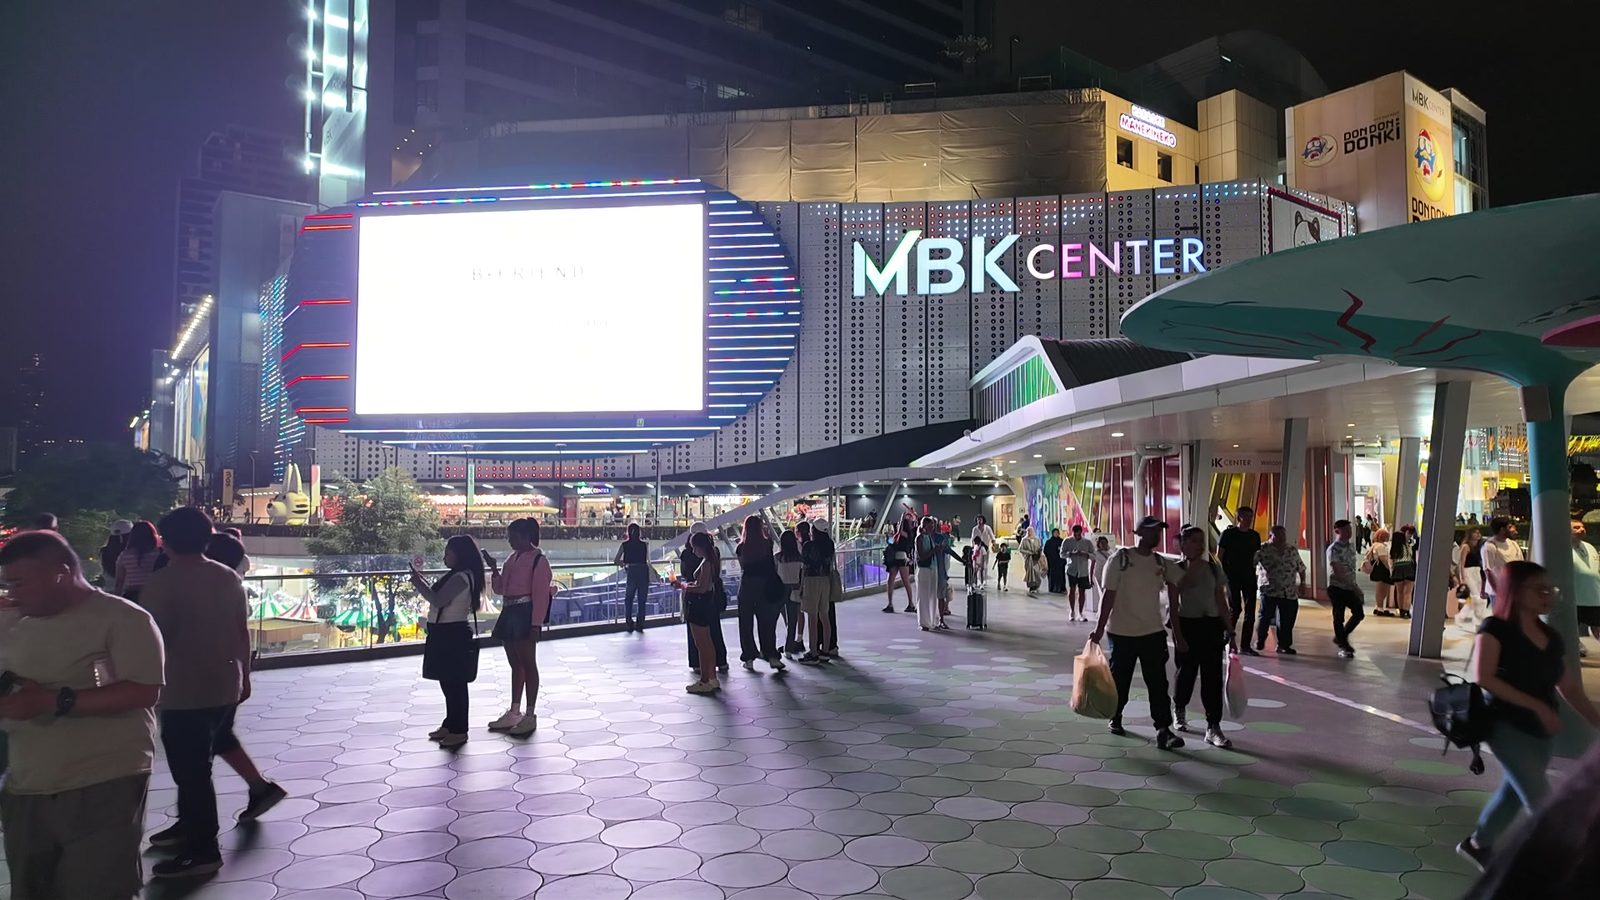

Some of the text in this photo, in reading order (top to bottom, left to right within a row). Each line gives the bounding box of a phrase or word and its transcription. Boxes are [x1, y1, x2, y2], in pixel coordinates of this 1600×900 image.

[1412, 88, 1428, 110] MBK
[1344, 119, 1394, 141] DON DON
[1412, 196, 1430, 218] DON
[853, 230, 1206, 296] MBK CENTER
[1036, 488, 1069, 532] PRIDE
